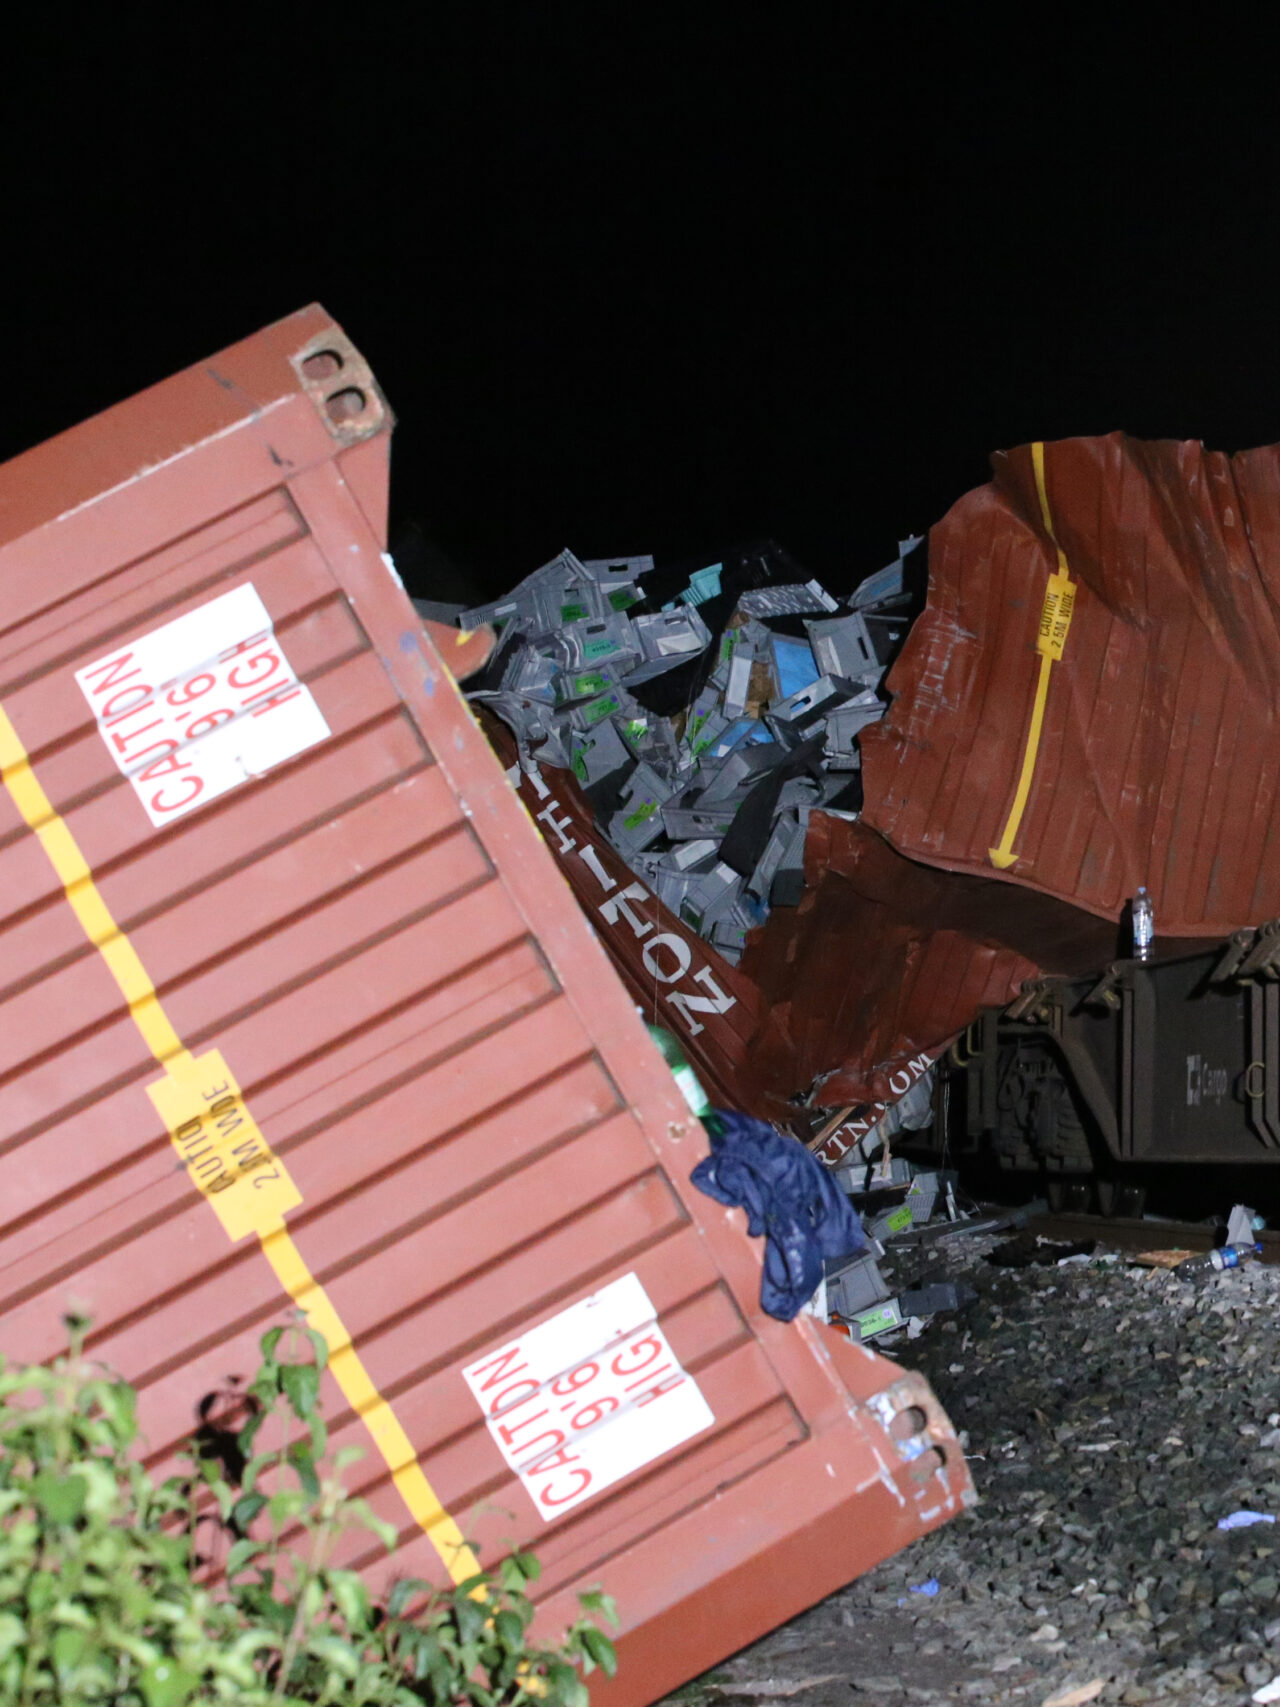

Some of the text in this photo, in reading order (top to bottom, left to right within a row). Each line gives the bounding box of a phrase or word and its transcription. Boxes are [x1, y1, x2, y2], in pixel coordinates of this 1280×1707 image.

[1040, 592, 1059, 637] CAUTION
[1059, 591, 1073, 618] WIDE
[218, 628, 301, 718] HIGH
[84, 652, 204, 813] CAUTION
[471, 1346, 592, 1506] CAUTION
